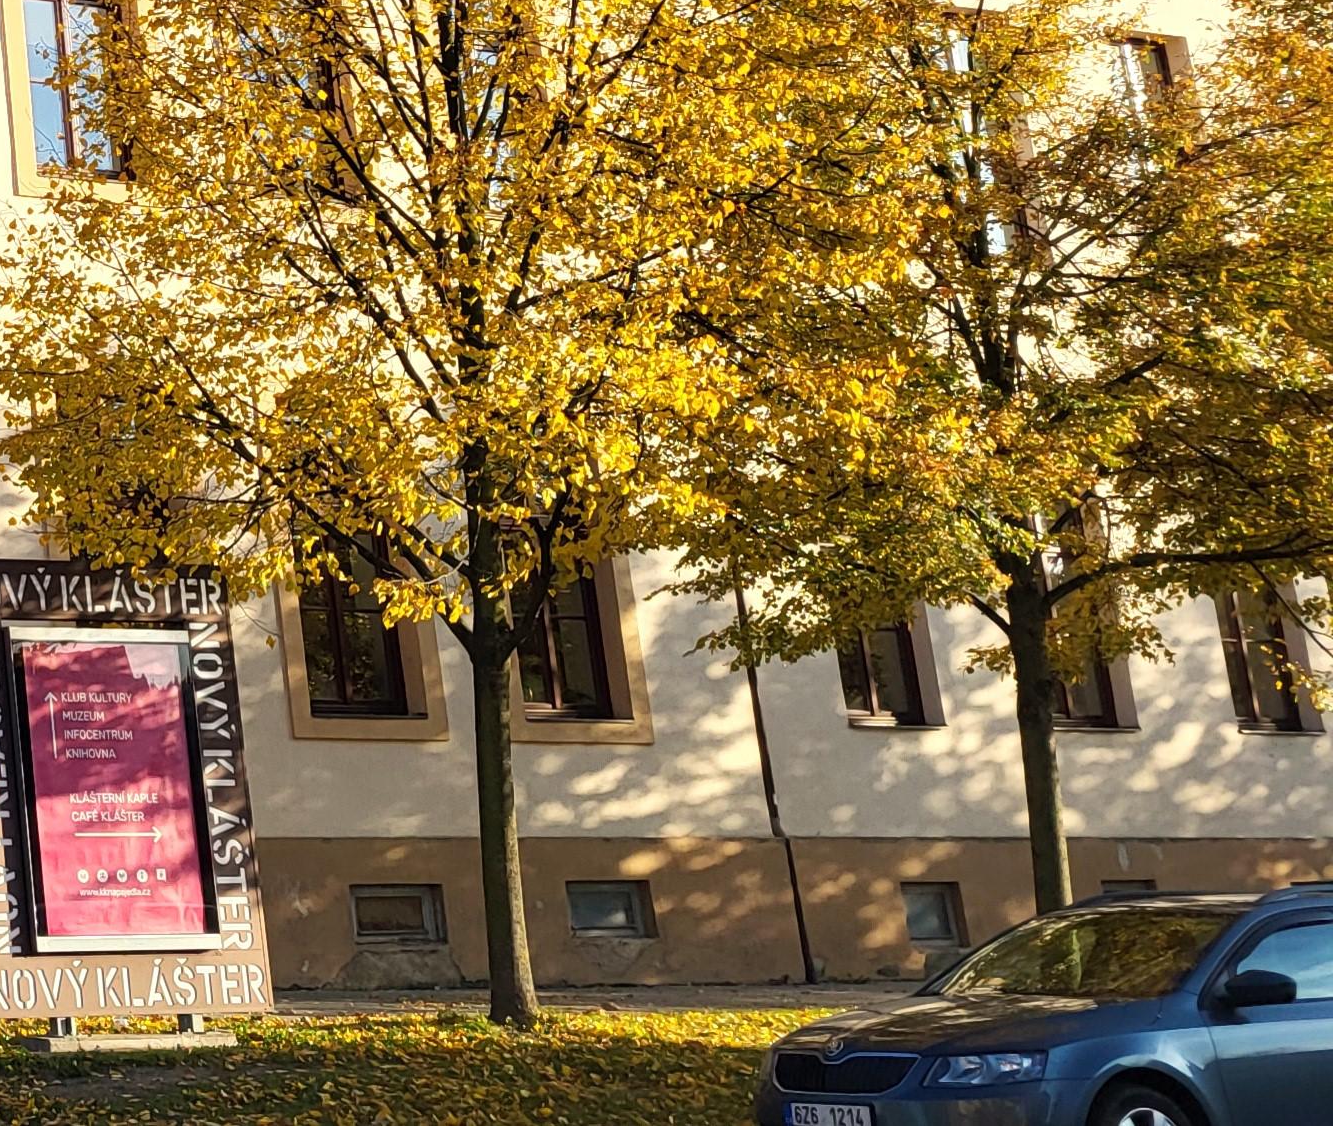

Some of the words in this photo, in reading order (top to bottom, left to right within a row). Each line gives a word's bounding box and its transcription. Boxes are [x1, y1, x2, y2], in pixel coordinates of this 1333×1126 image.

[189, 622, 236, 740] NOVÝ
[61, 692, 86, 703] KLUB
[89, 692, 132, 703] KULTURY
[62, 711, 104, 722] MUZEUM
[64, 729, 133, 741] INFOCENTRUM
[66, 748, 116, 759] KNIHOVNA
[69, 790, 125, 804] KLÁŠTERNÍ
[127, 793, 159, 804] KAPLE
[100, 808, 145, 822] KLÁŠTER
[202, 749, 254, 950] KLÁŠTER
[97, 958, 266, 1009] KLÁŠTER
[794, 1106, 819, 1125] 6Z6
[830, 1107, 865, 1126] 1214
